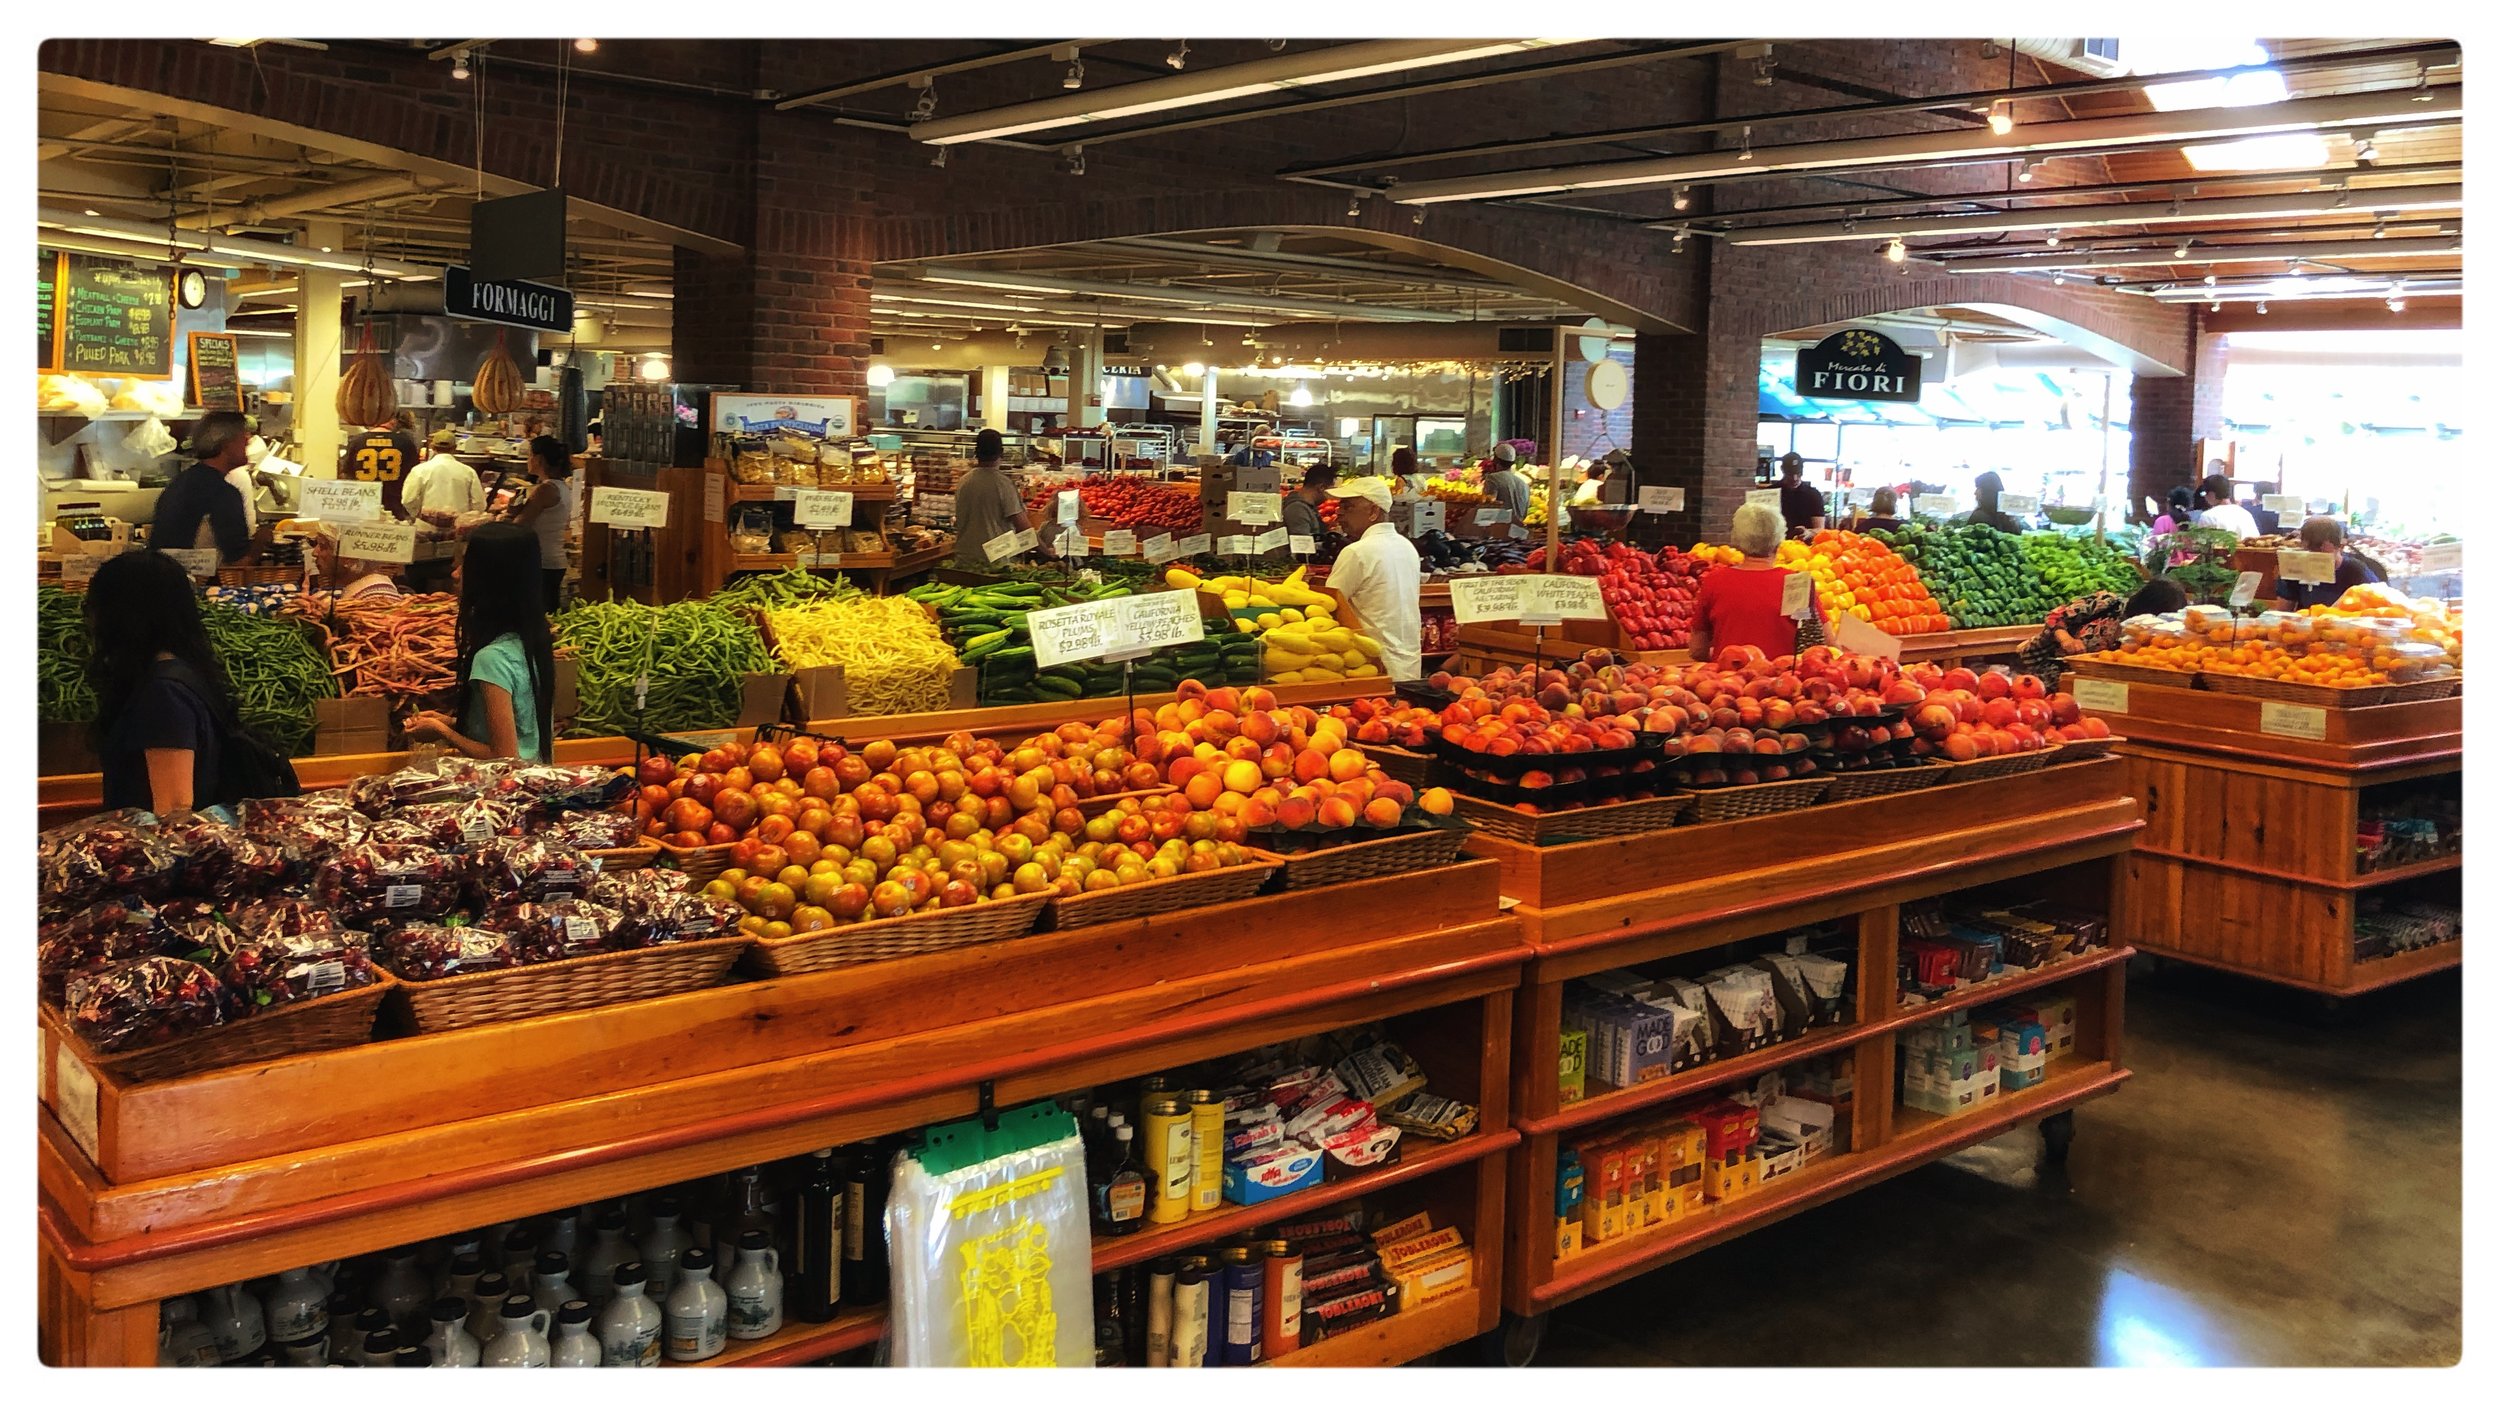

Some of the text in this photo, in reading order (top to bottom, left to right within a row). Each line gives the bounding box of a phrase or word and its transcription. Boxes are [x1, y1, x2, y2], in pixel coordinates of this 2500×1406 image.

[76, 301, 104, 314] CHICKEN
[472, 282, 555, 322] FORMAGGI
[76, 344, 106, 362] PULLED
[109, 347, 131, 365] PORK
[1828, 361, 1887, 373] Mercato di
[1813, 371, 1905, 393] FIORI
[355, 448, 402, 481] 33
[307, 486, 377, 498] SHELL BEANS
[345, 529, 381, 540] RUNNER
[381, 533, 410, 543] BEANS
[1473, 586, 1517, 595] CALIFORNIA
[1543, 579, 1591, 590] CALIFORNIA
[1536, 590, 1600, 601] WHITE PEACHES
[1038, 616, 1079, 630] ROSETTA
[1080, 608, 1115, 622] ROYALE
[1133, 605, 1182, 620] CALIFORNIA
[1062, 624, 1094, 638] PLUMS
[1125, 614, 1197, 632] YELLOW PEACHES
[1637, 1015, 1673, 1039] MADE
[1560, 1035, 1583, 1056] ADE
[1636, 1033, 1671, 1056] GOOD
[1391, 1231, 1454, 1262] TOBLERONE
[1318, 1290, 1385, 1319] TOBLERONE
